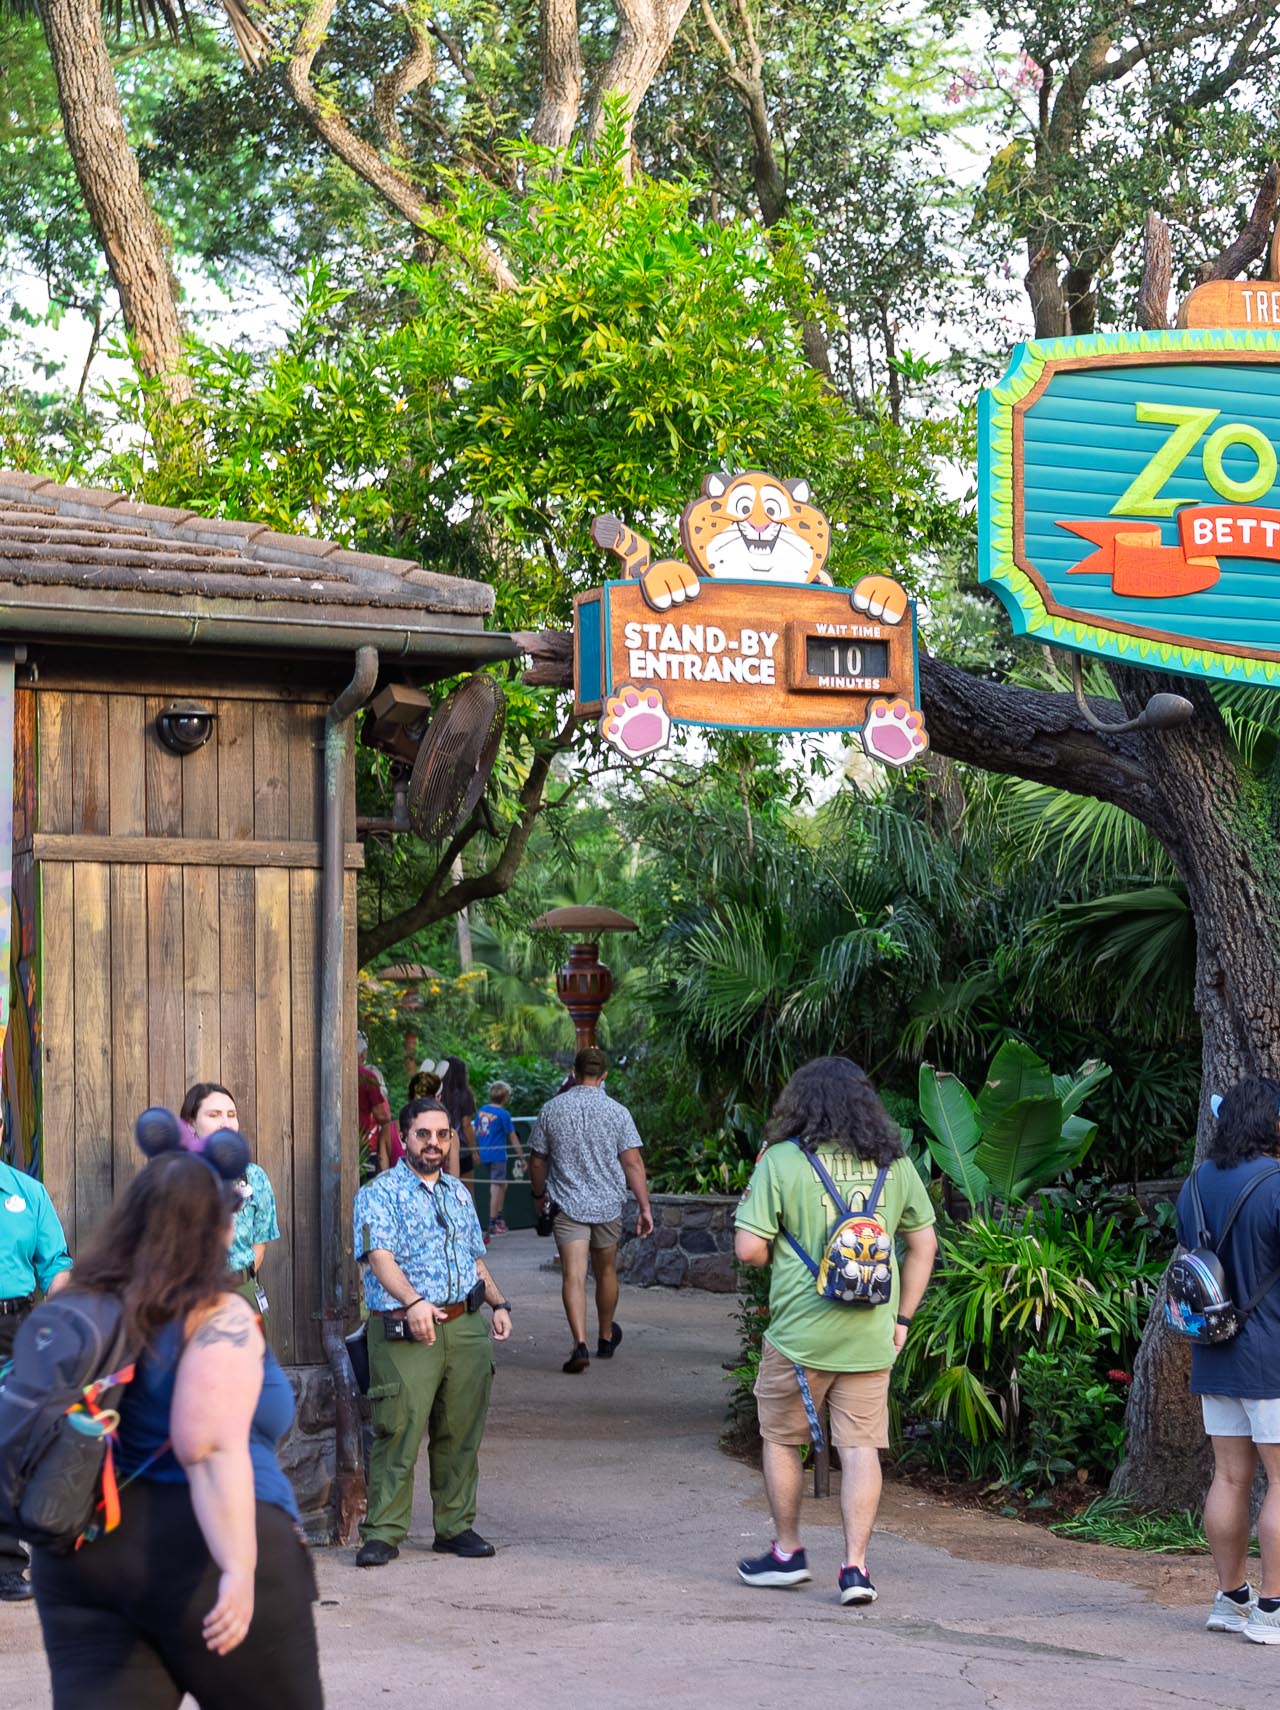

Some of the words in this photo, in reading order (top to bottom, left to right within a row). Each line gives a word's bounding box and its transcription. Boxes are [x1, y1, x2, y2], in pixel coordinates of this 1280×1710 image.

[624, 621, 779, 657] STAND-BY
[816, 623, 848, 636] WAIT
[852, 625, 881, 638] TIME
[629, 651, 776, 685] ENTRANCE
[830, 645, 862, 676] 10
[818, 676, 881, 690] MINUTES
[811, 1152, 894, 1183] WILD
